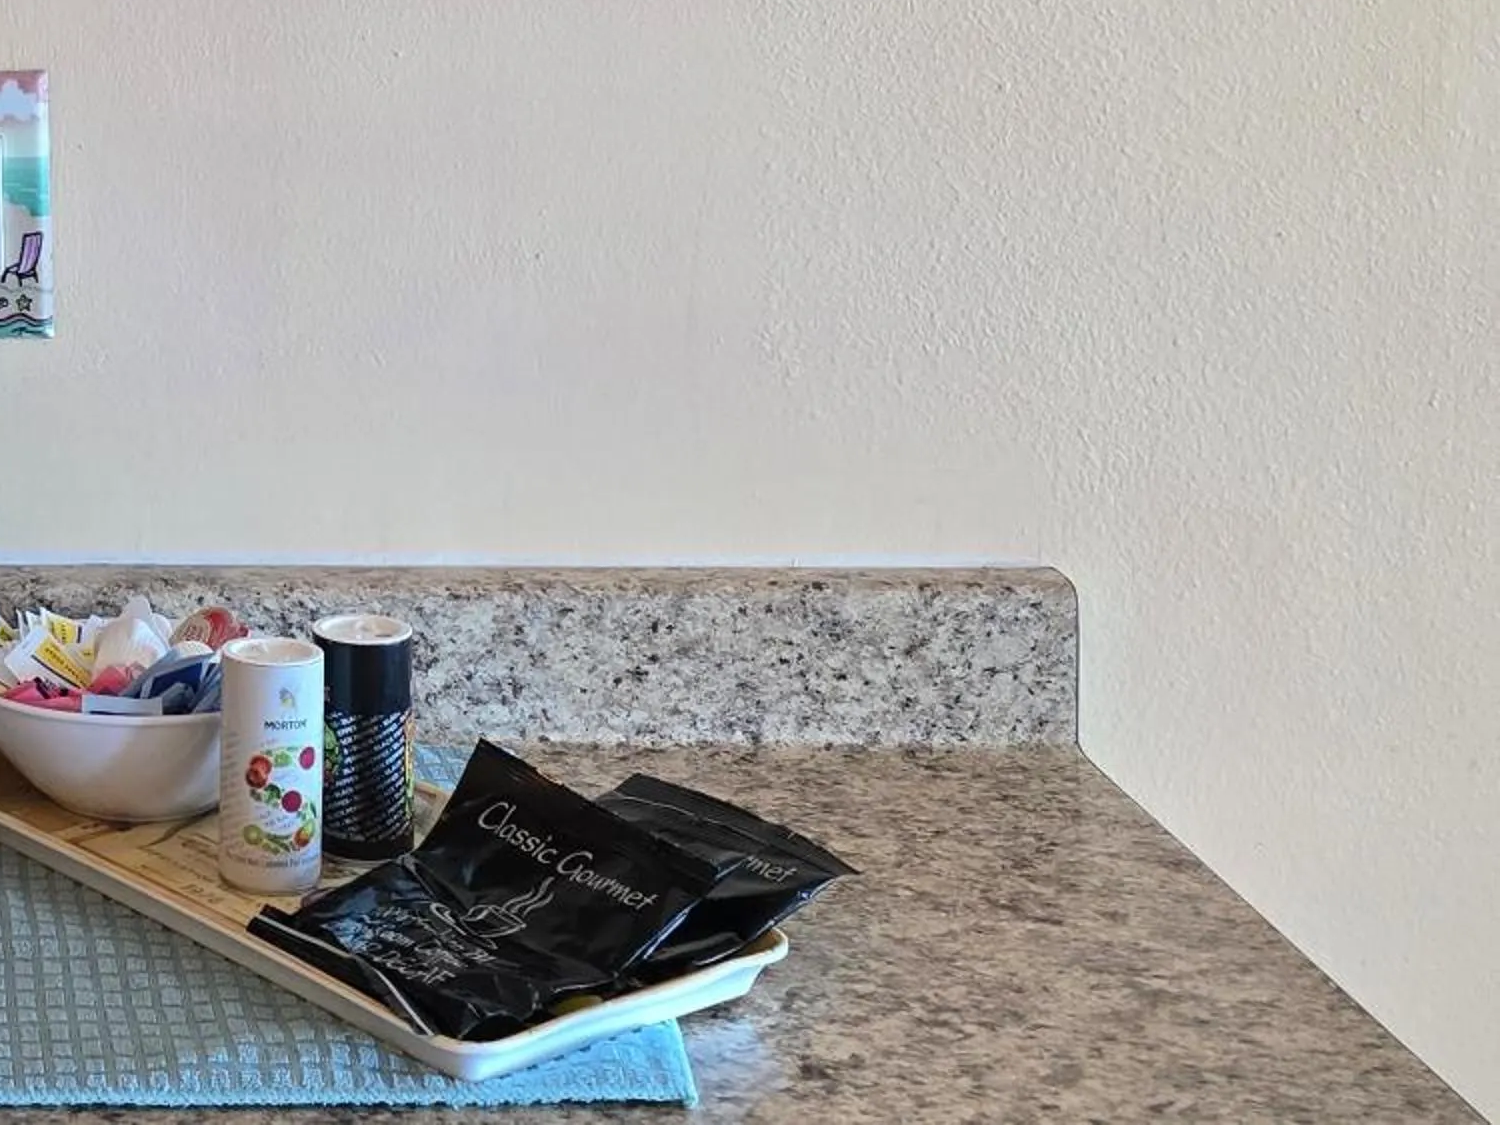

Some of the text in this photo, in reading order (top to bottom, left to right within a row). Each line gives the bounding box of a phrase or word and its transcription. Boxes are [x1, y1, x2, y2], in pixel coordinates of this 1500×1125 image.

[263, 719, 308, 732] MORTON
[478, 801, 659, 911] Classic Gourmet
